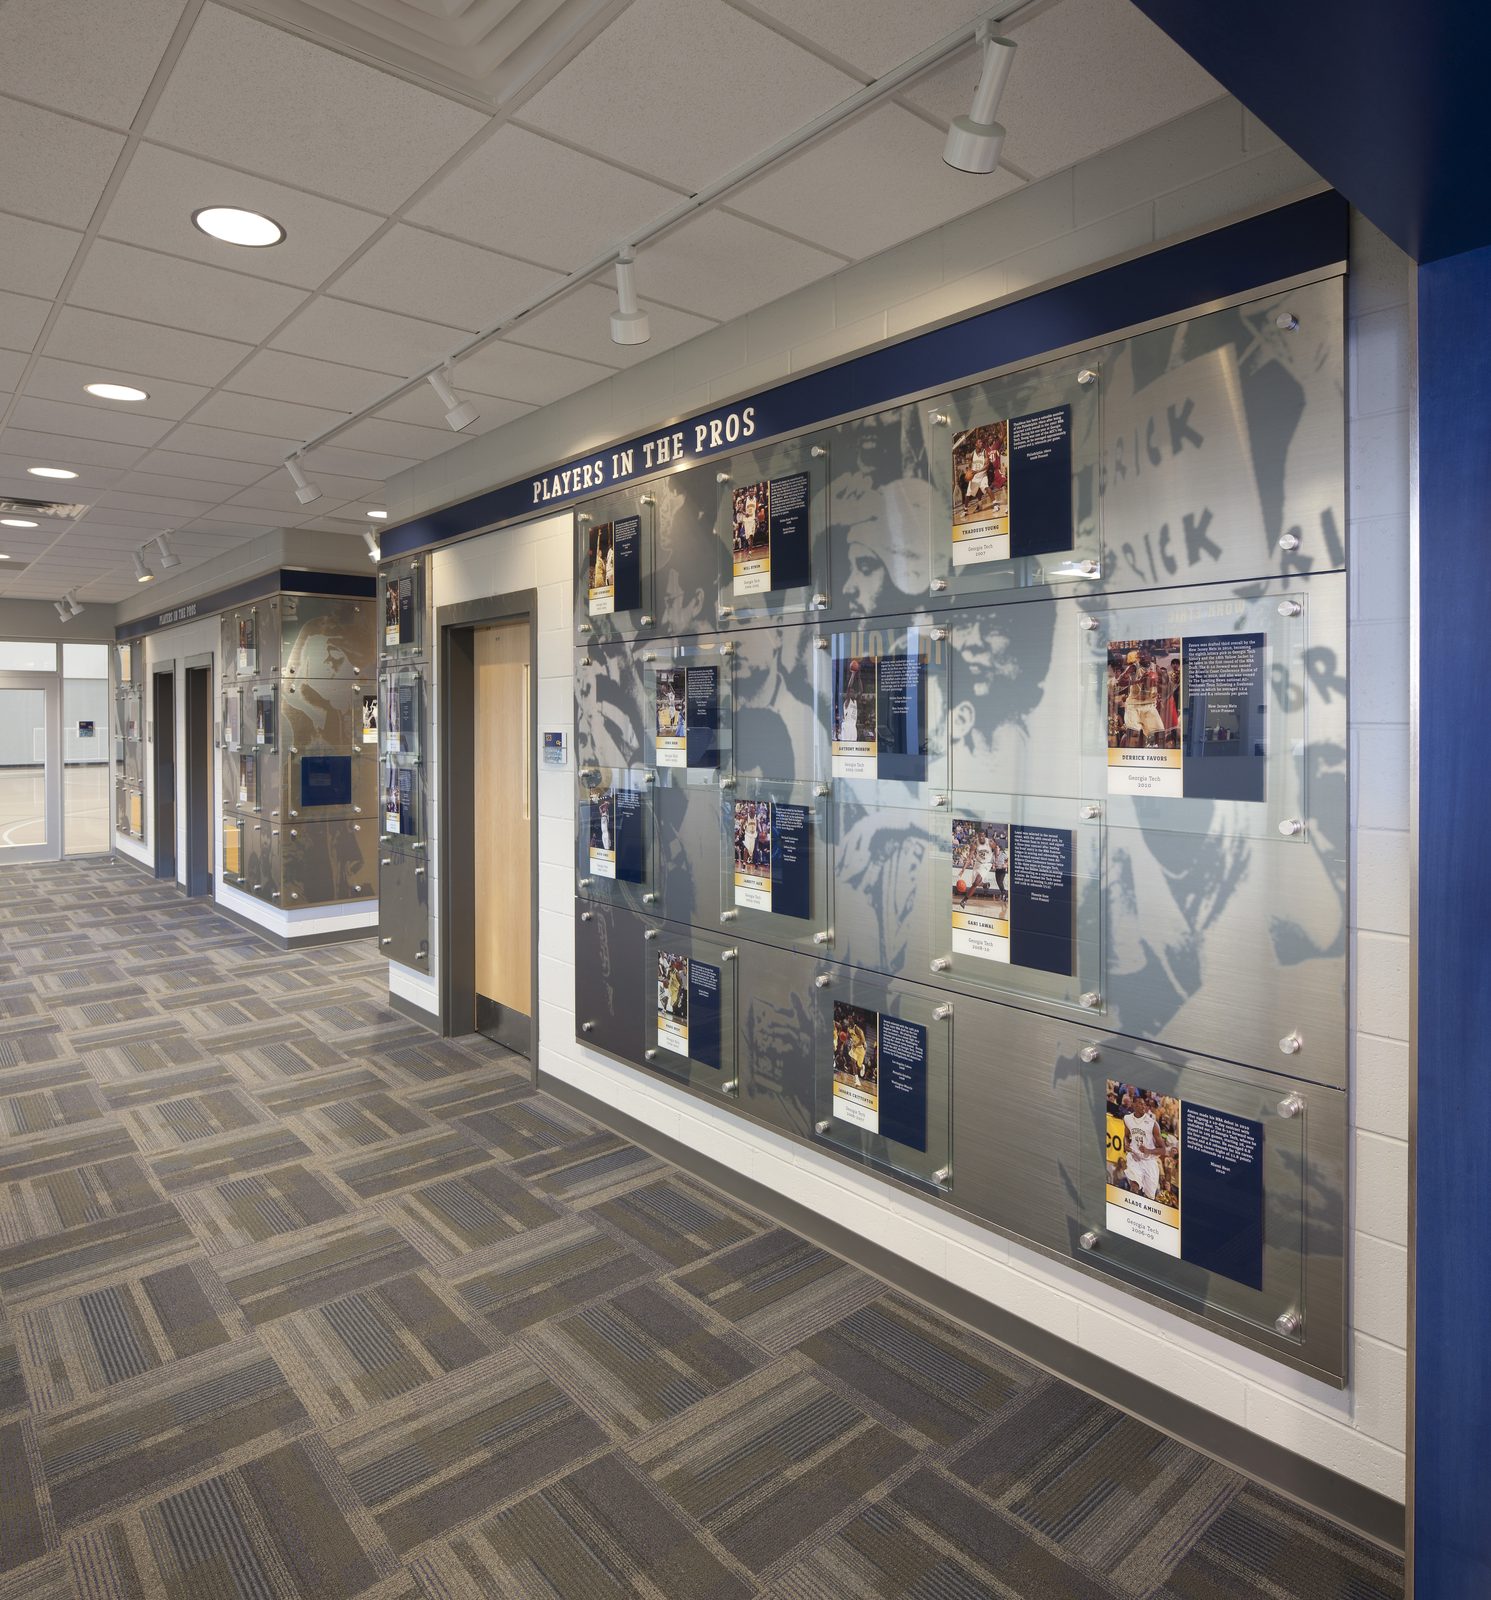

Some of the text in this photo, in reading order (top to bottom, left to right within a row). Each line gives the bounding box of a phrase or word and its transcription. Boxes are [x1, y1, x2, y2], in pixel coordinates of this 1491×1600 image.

[532, 408, 755, 503] PLAYERS IN THE PROS
[1124, 1198, 1162, 1215] ALADE AMINU
[1127, 1218, 1159, 1234] Georgia Tech
